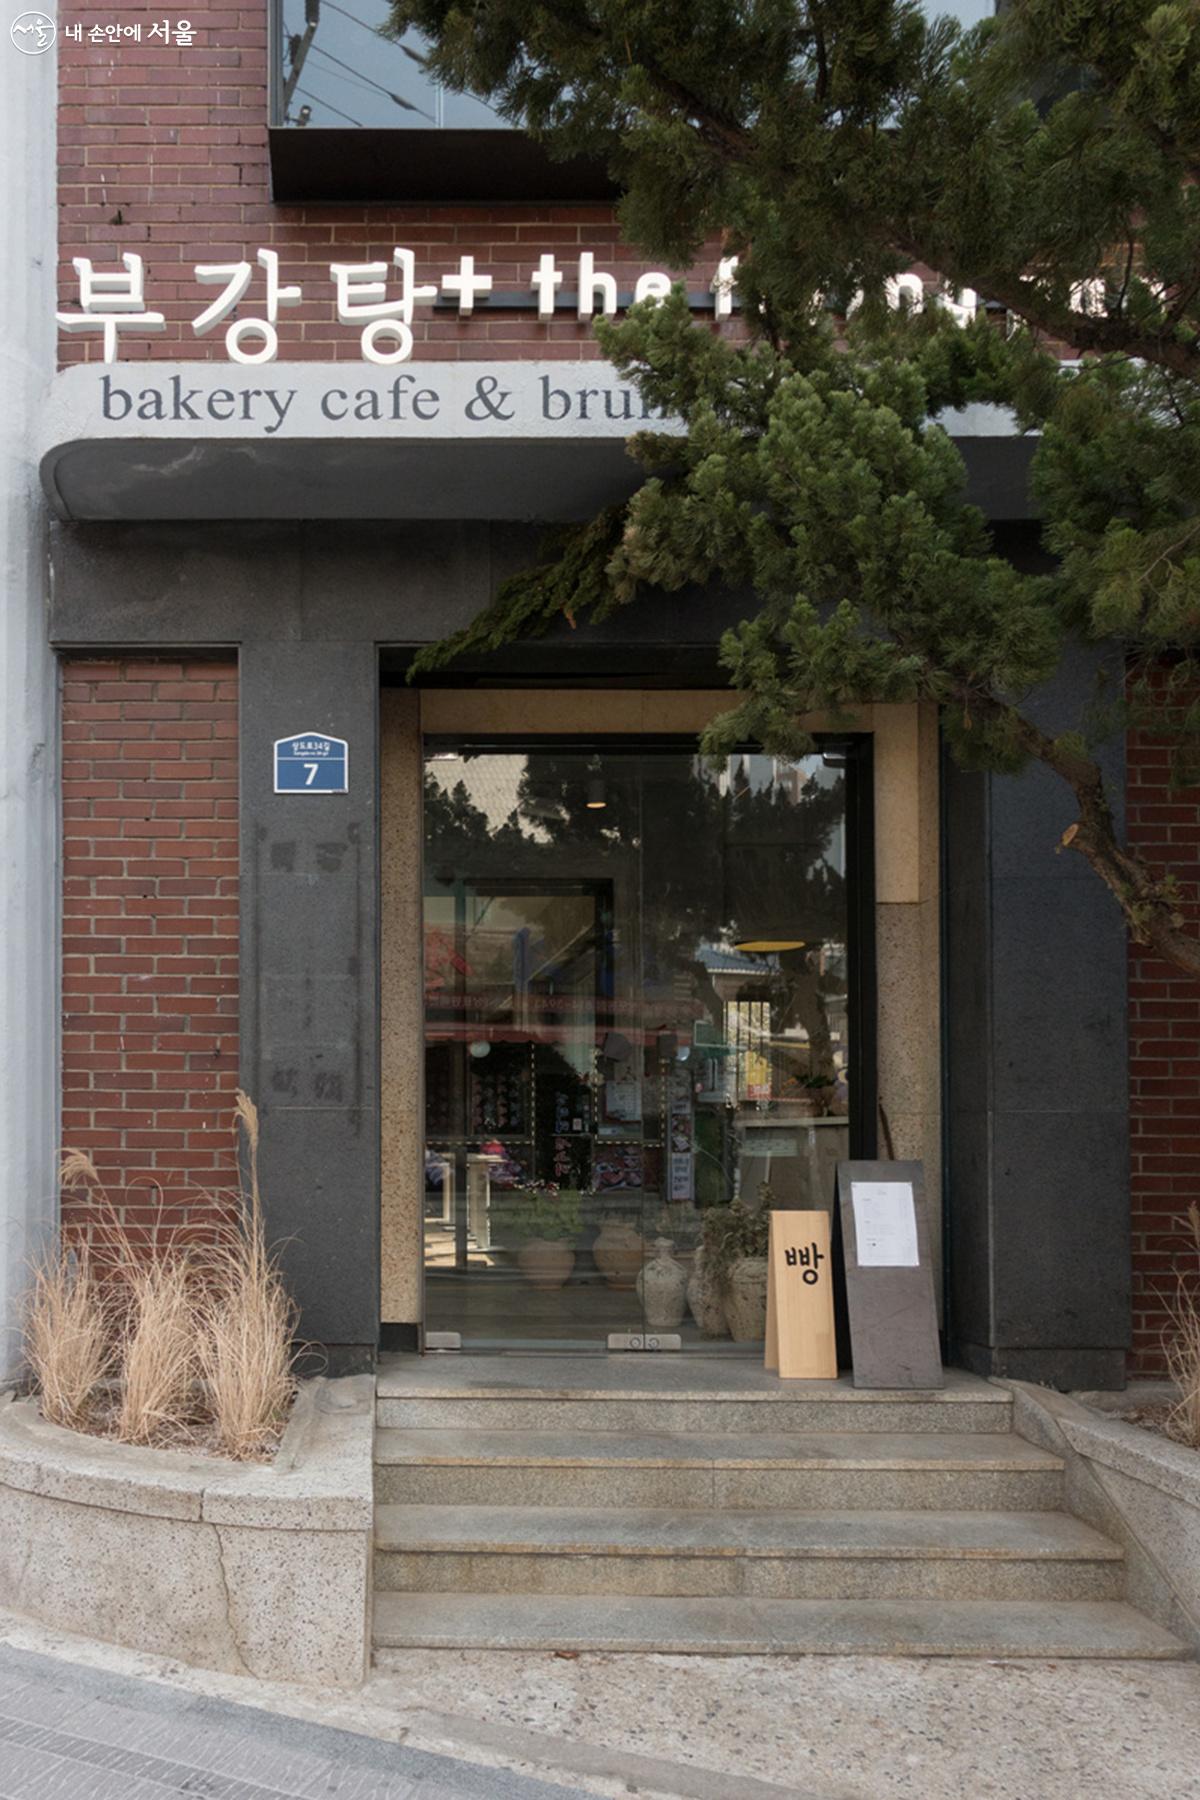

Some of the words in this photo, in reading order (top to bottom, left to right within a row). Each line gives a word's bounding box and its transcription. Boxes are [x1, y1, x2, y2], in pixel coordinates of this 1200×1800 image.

[531, 252, 673, 321] the
[101, 375, 298, 433] bakery
[320, 374, 441, 421] cafe
[464, 375, 516, 422] &
[538, 374, 673, 421] bru
[303, 763, 319, 785] 7
[785, 1243, 824, 1286] 빵
